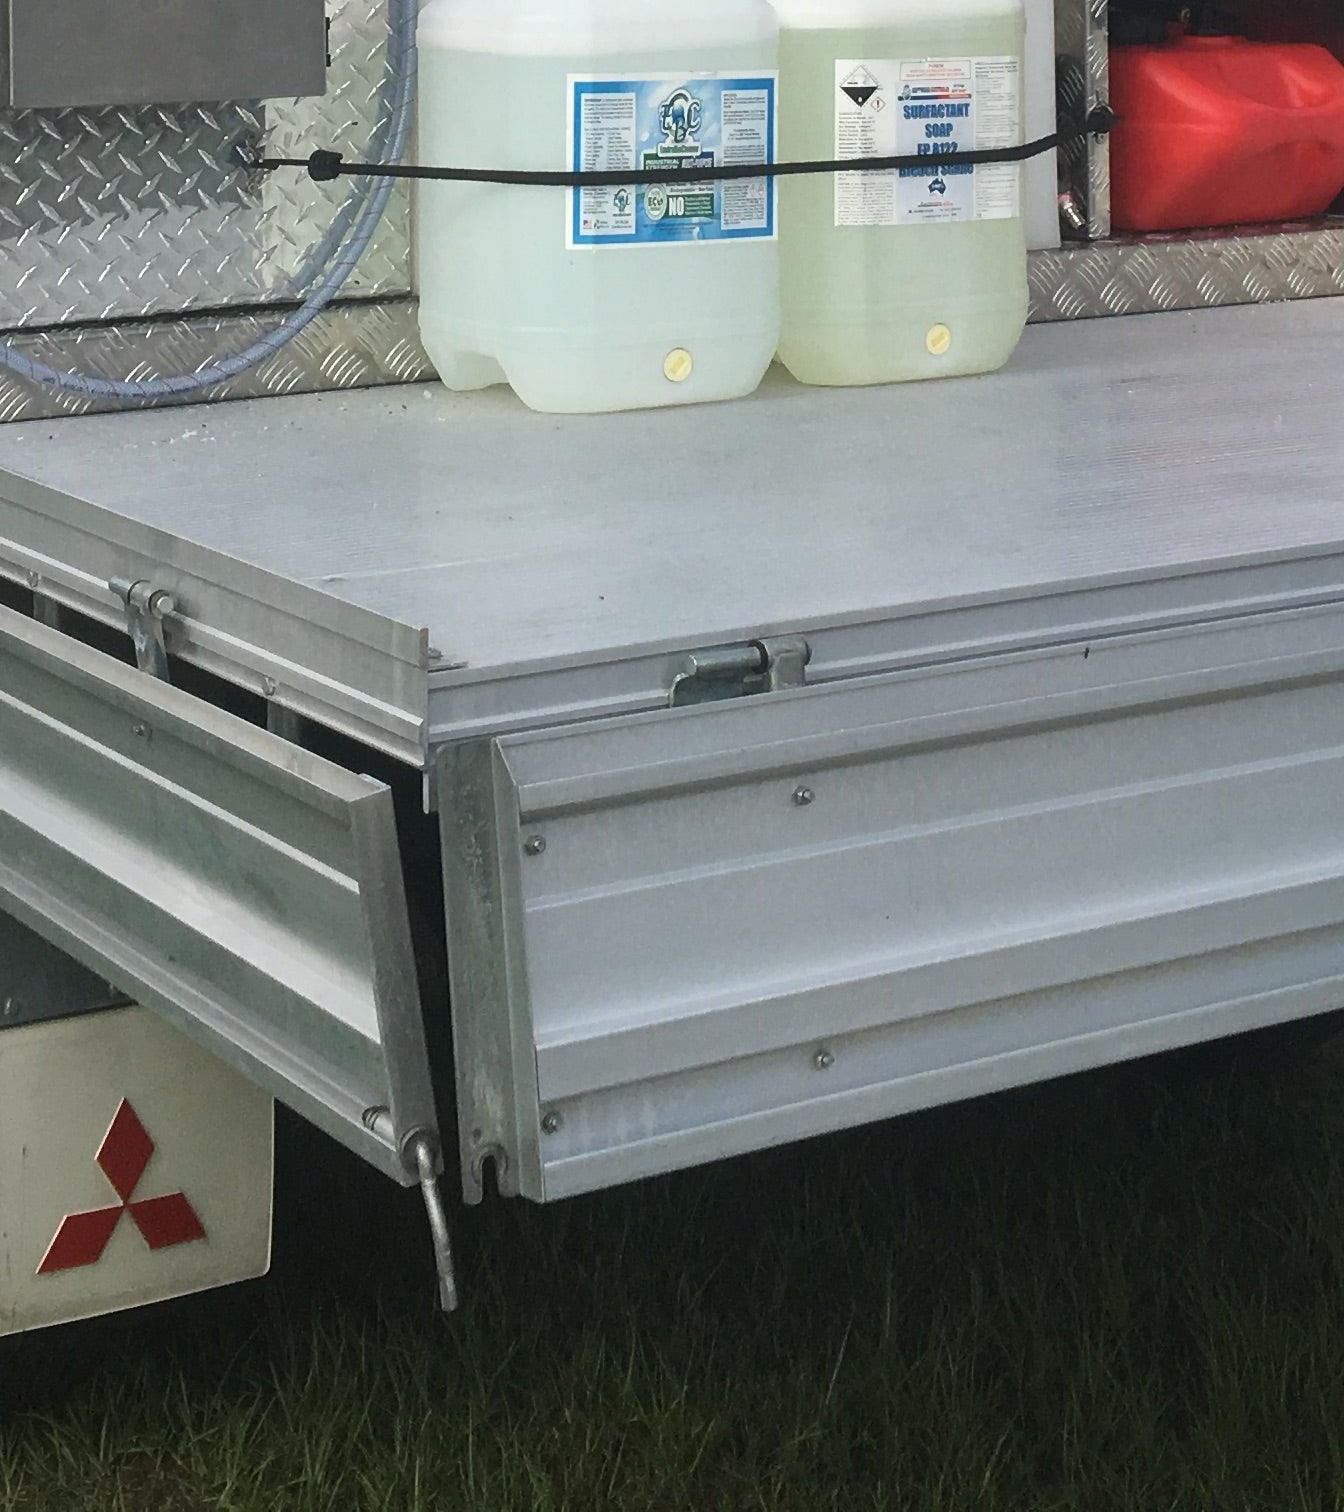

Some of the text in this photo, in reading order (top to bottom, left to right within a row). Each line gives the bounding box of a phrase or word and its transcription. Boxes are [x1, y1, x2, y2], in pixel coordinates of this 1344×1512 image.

[903, 103, 970, 119] SURFACTANT
[925, 122, 954, 138] SOAP
[668, 196, 685, 217] NO
